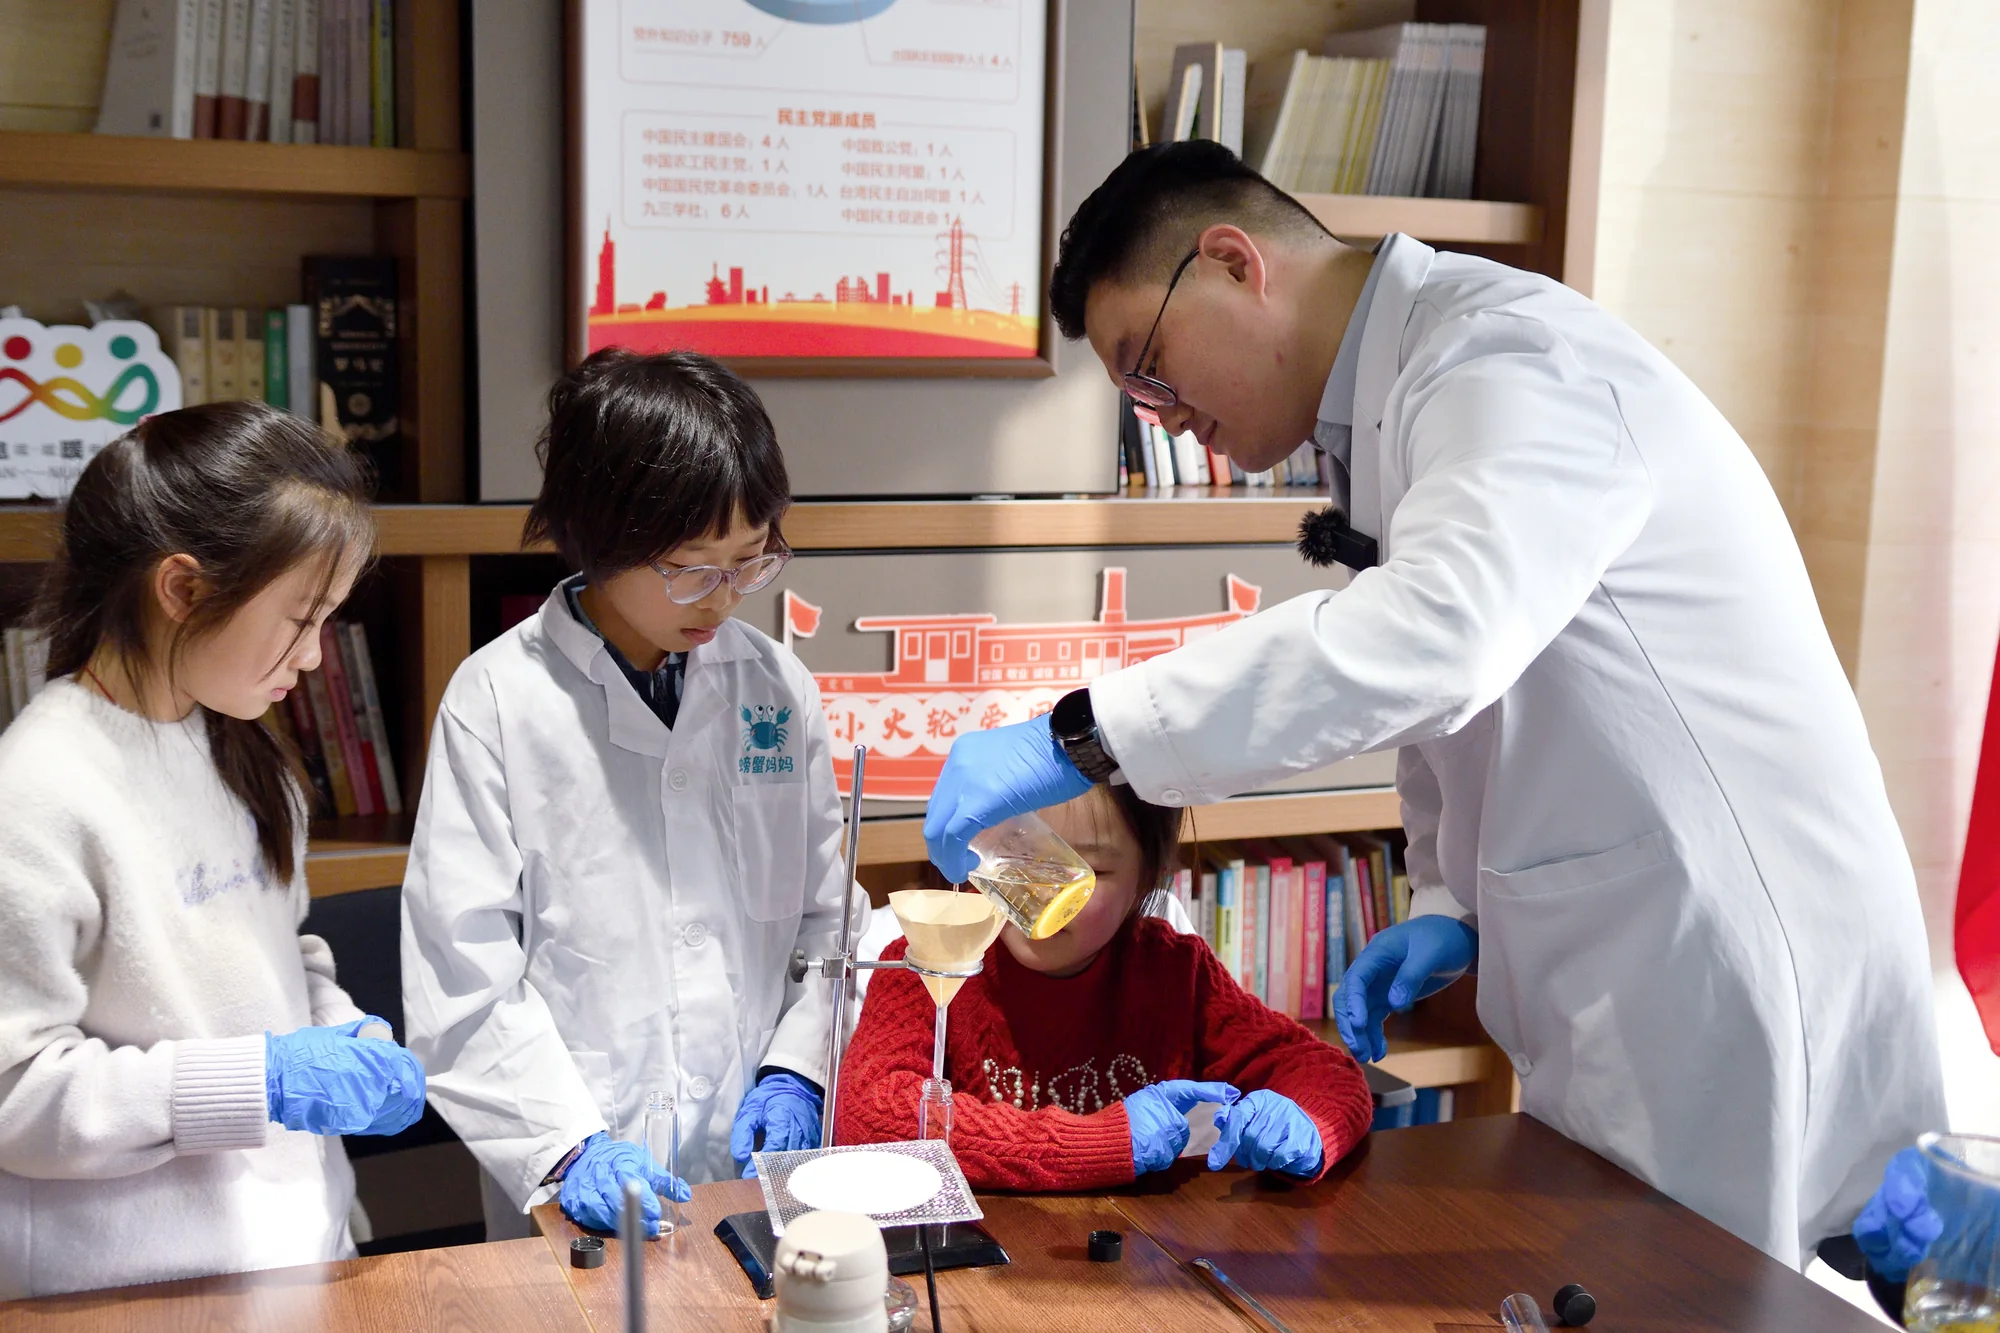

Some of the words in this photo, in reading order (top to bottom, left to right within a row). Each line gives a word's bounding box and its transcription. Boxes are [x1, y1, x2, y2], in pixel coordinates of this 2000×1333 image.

[722, 30, 751, 47] 759
[777, 108, 876, 129] 民主党派成员
[739, 755, 794, 773] 螃蟹妈妈
